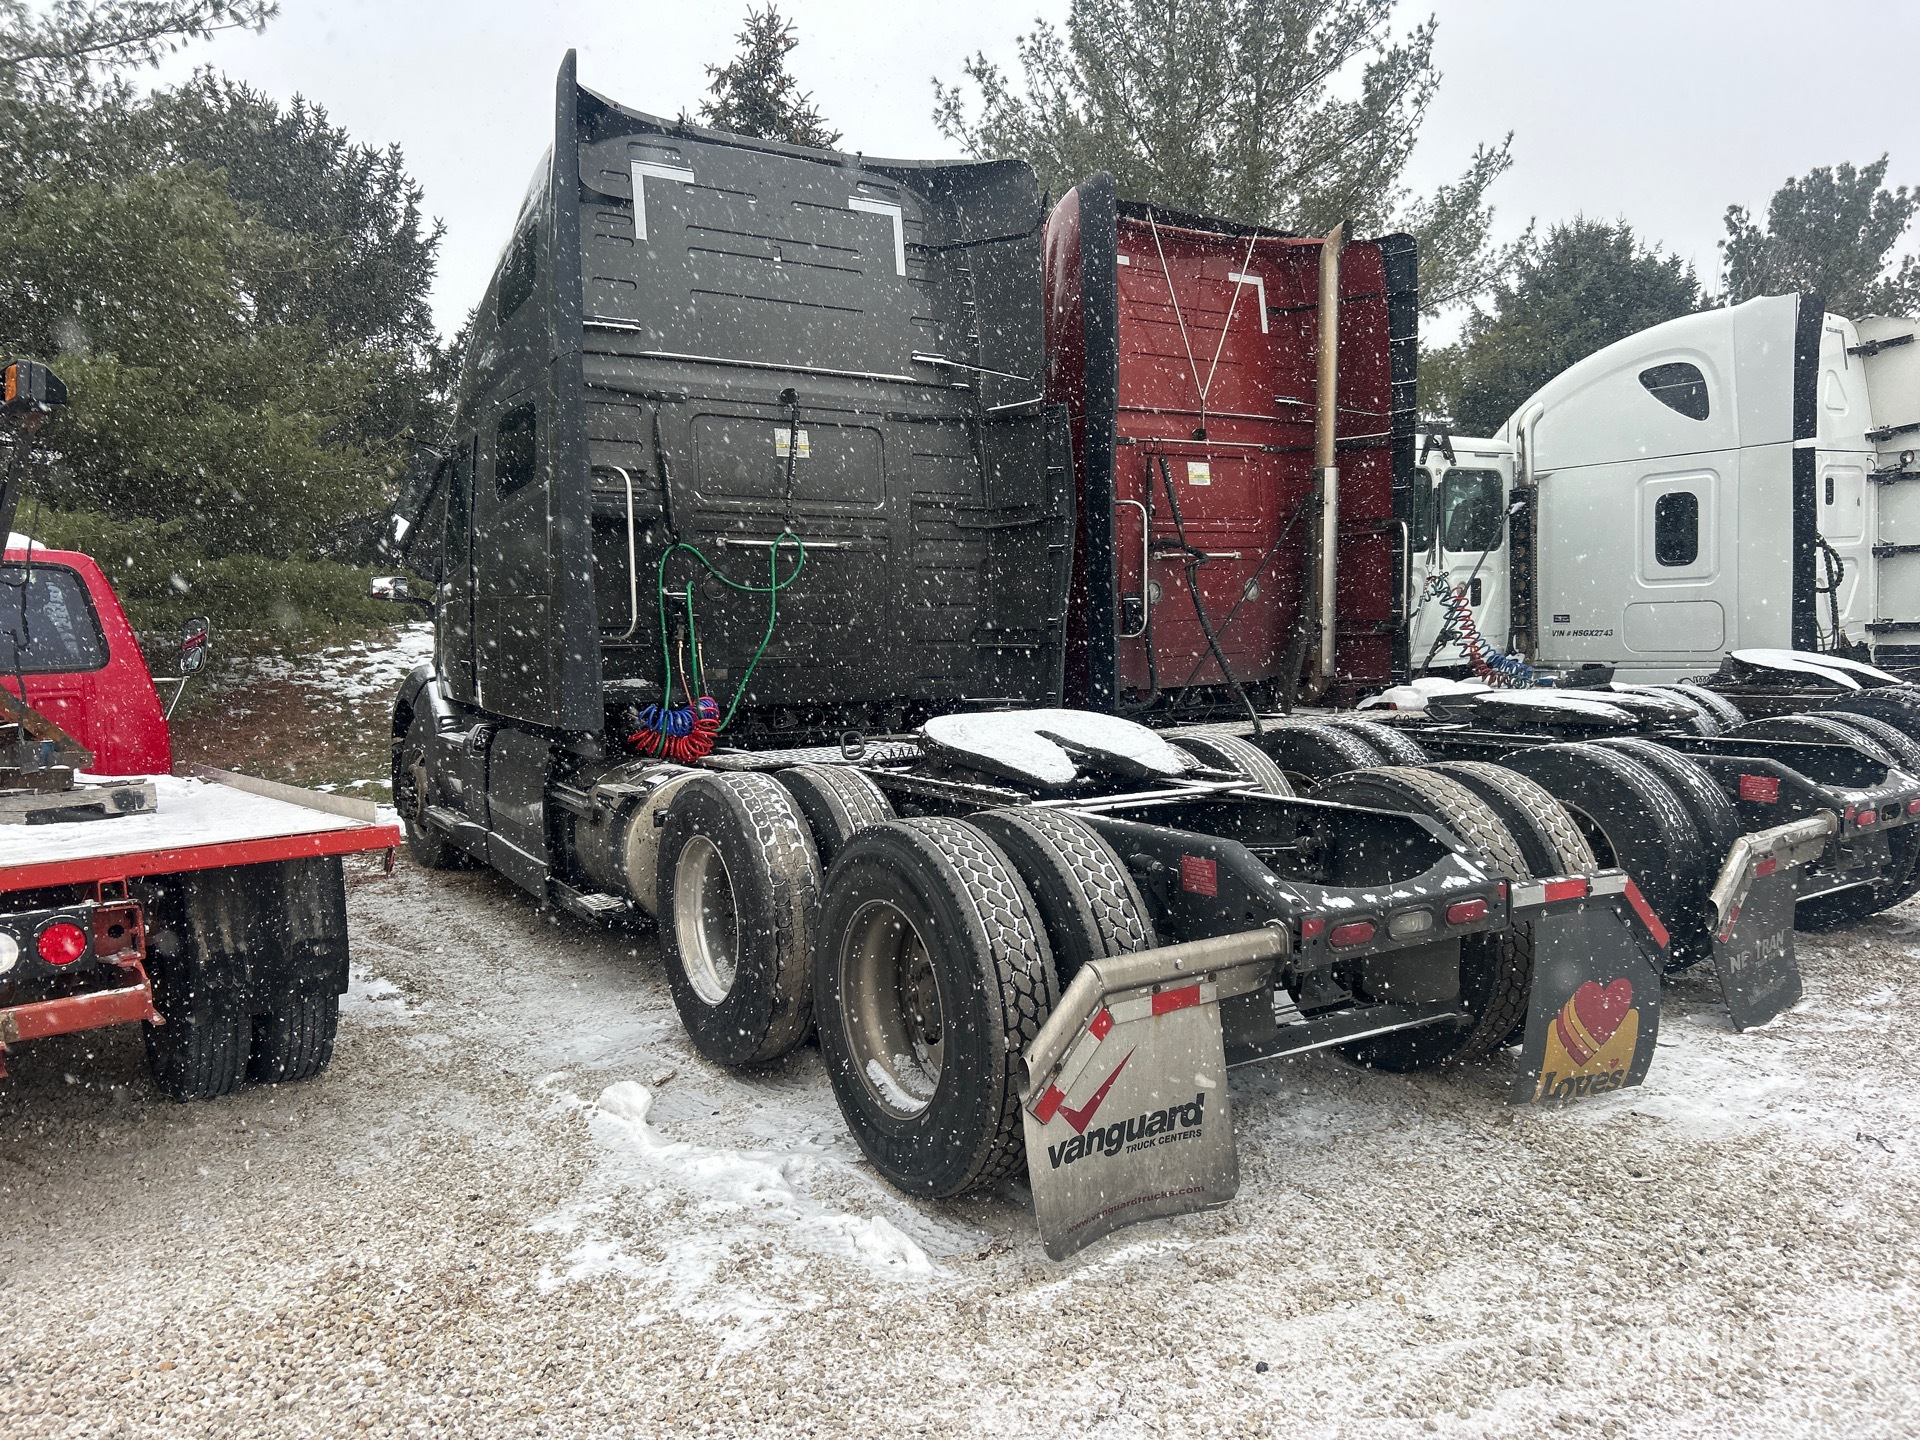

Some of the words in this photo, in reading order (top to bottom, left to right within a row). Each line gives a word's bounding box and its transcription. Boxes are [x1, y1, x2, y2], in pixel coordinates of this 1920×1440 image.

[1572, 629, 1613, 637] HSGX2743
[1047, 1092, 1206, 1169] vanguard
[1126, 1138, 1156, 1154] TRUCK
[1158, 1129, 1203, 1145] CENTERS
[1066, 1185, 1206, 1235] www.vanguardtrucks.com
